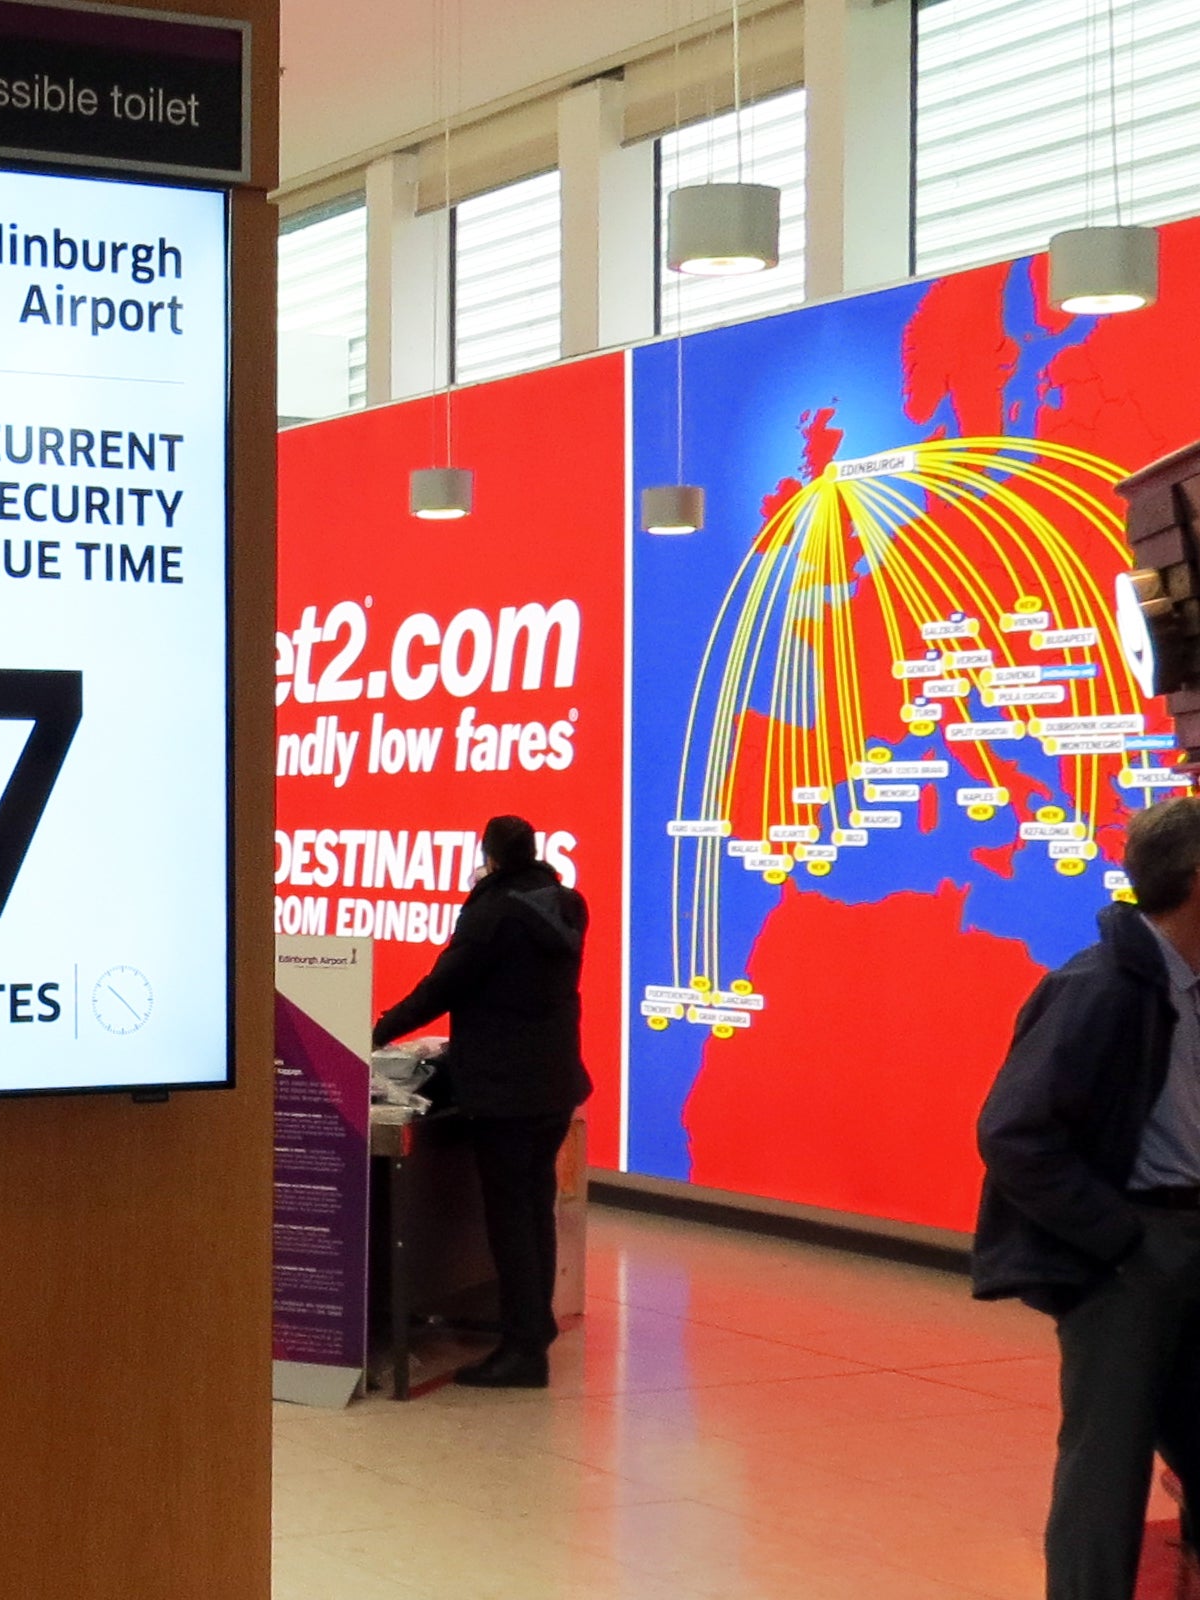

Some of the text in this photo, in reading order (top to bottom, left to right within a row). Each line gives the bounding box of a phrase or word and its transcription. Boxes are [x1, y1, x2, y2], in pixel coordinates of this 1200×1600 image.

[110, 86, 199, 126] toilet
[19, 284, 183, 336] Airport
[840, 457, 905, 476] EDINBURGH
[76, 543, 184, 584] TIME
[1046, 632, 1093, 645] BUDAPEST
[368, 712, 443, 774] low
[455, 706, 575, 773] fares
[1060, 739, 1122, 751] MONTENEGRO
[275, 828, 577, 892] DESTINATIS
